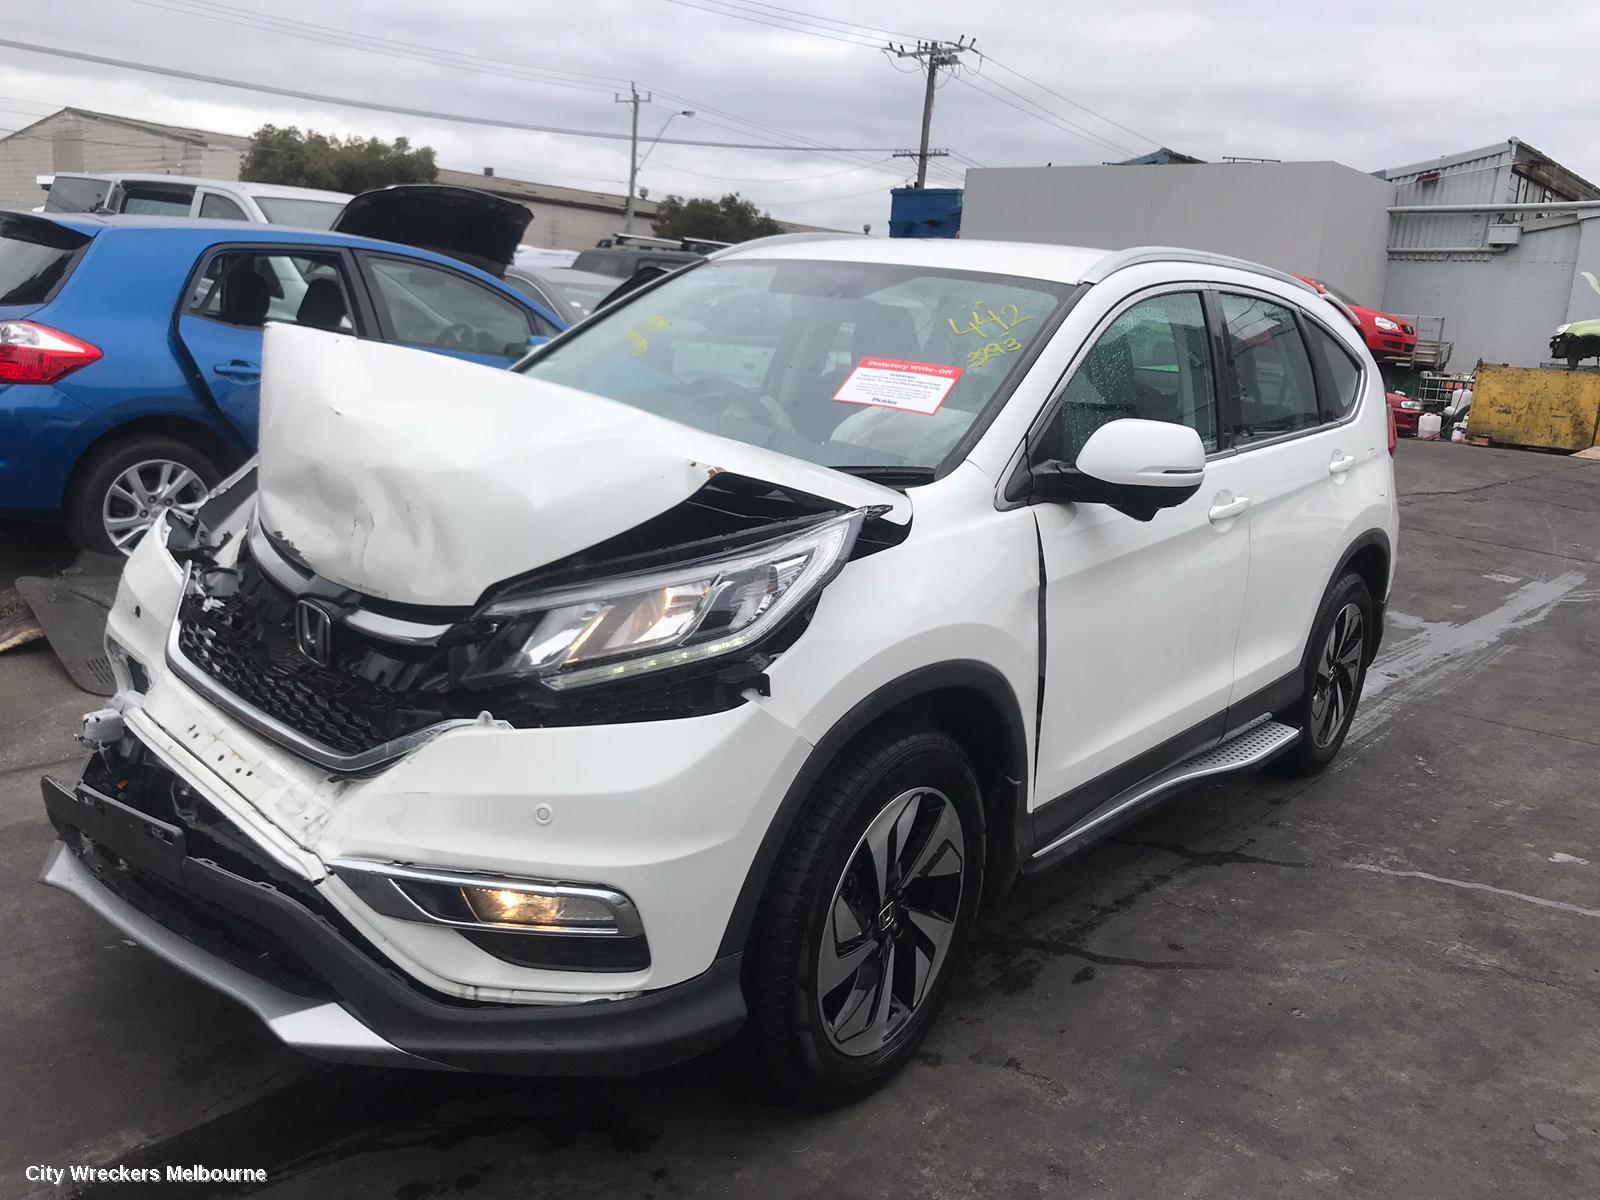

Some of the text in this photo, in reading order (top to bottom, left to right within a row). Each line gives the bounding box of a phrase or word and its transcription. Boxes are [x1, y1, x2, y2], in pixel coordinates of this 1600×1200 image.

[948, 303, 1034, 338] 442
[868, 360, 954, 375] Statutory Write-Off
